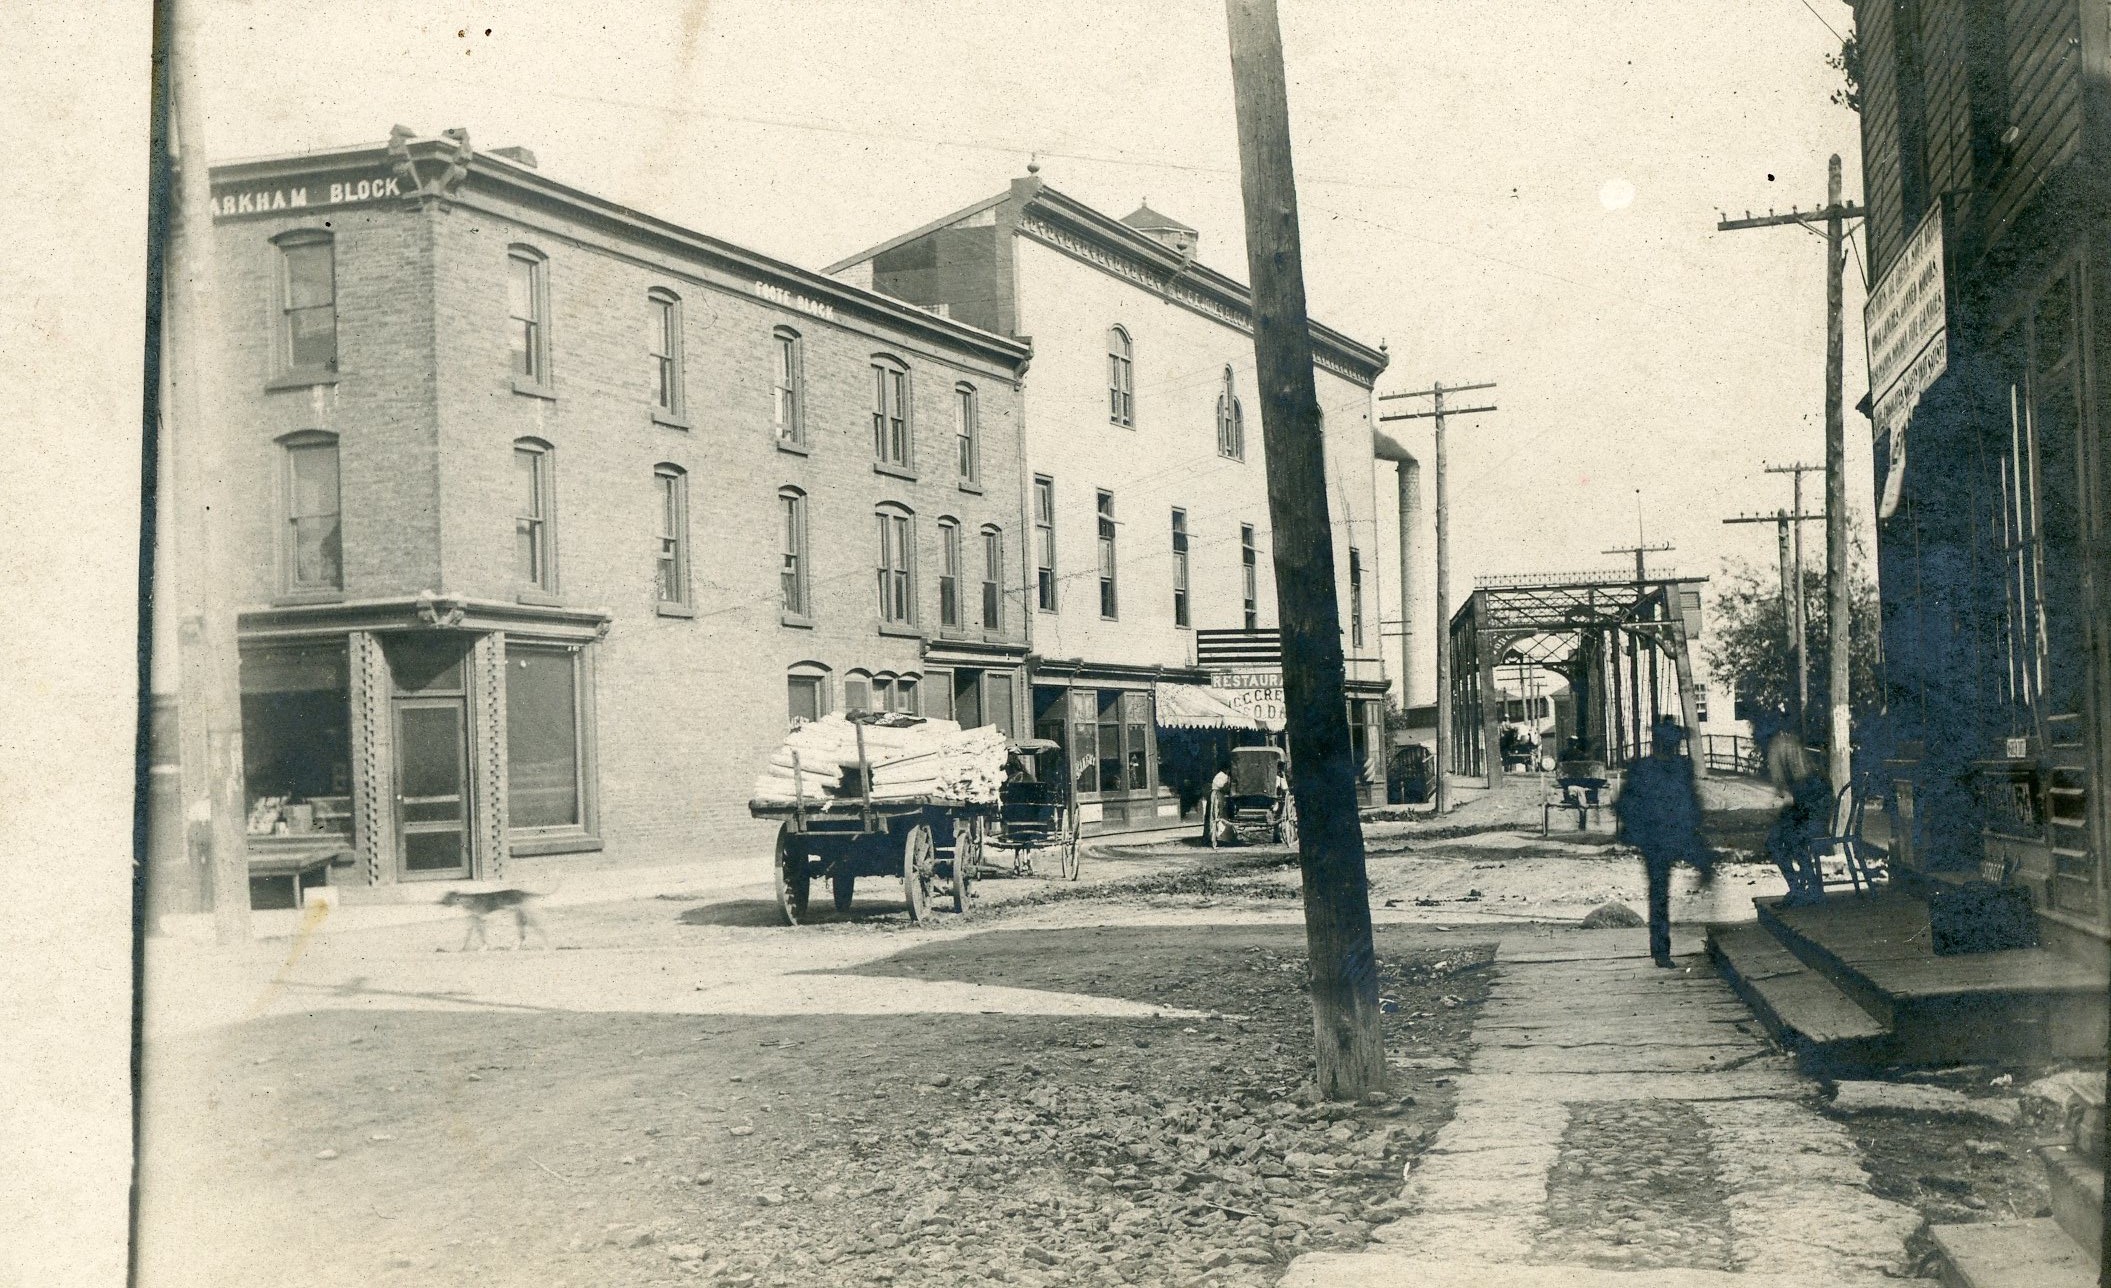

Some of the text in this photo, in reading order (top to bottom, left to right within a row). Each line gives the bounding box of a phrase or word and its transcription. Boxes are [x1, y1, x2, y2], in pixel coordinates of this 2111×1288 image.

[210, 177, 400, 216] ARKHAM BLOCK
[797, 295, 834, 320] BLOCK
[1213, 673, 1283, 687] RESTAUR
[1254, 689, 1283, 702] CRE
